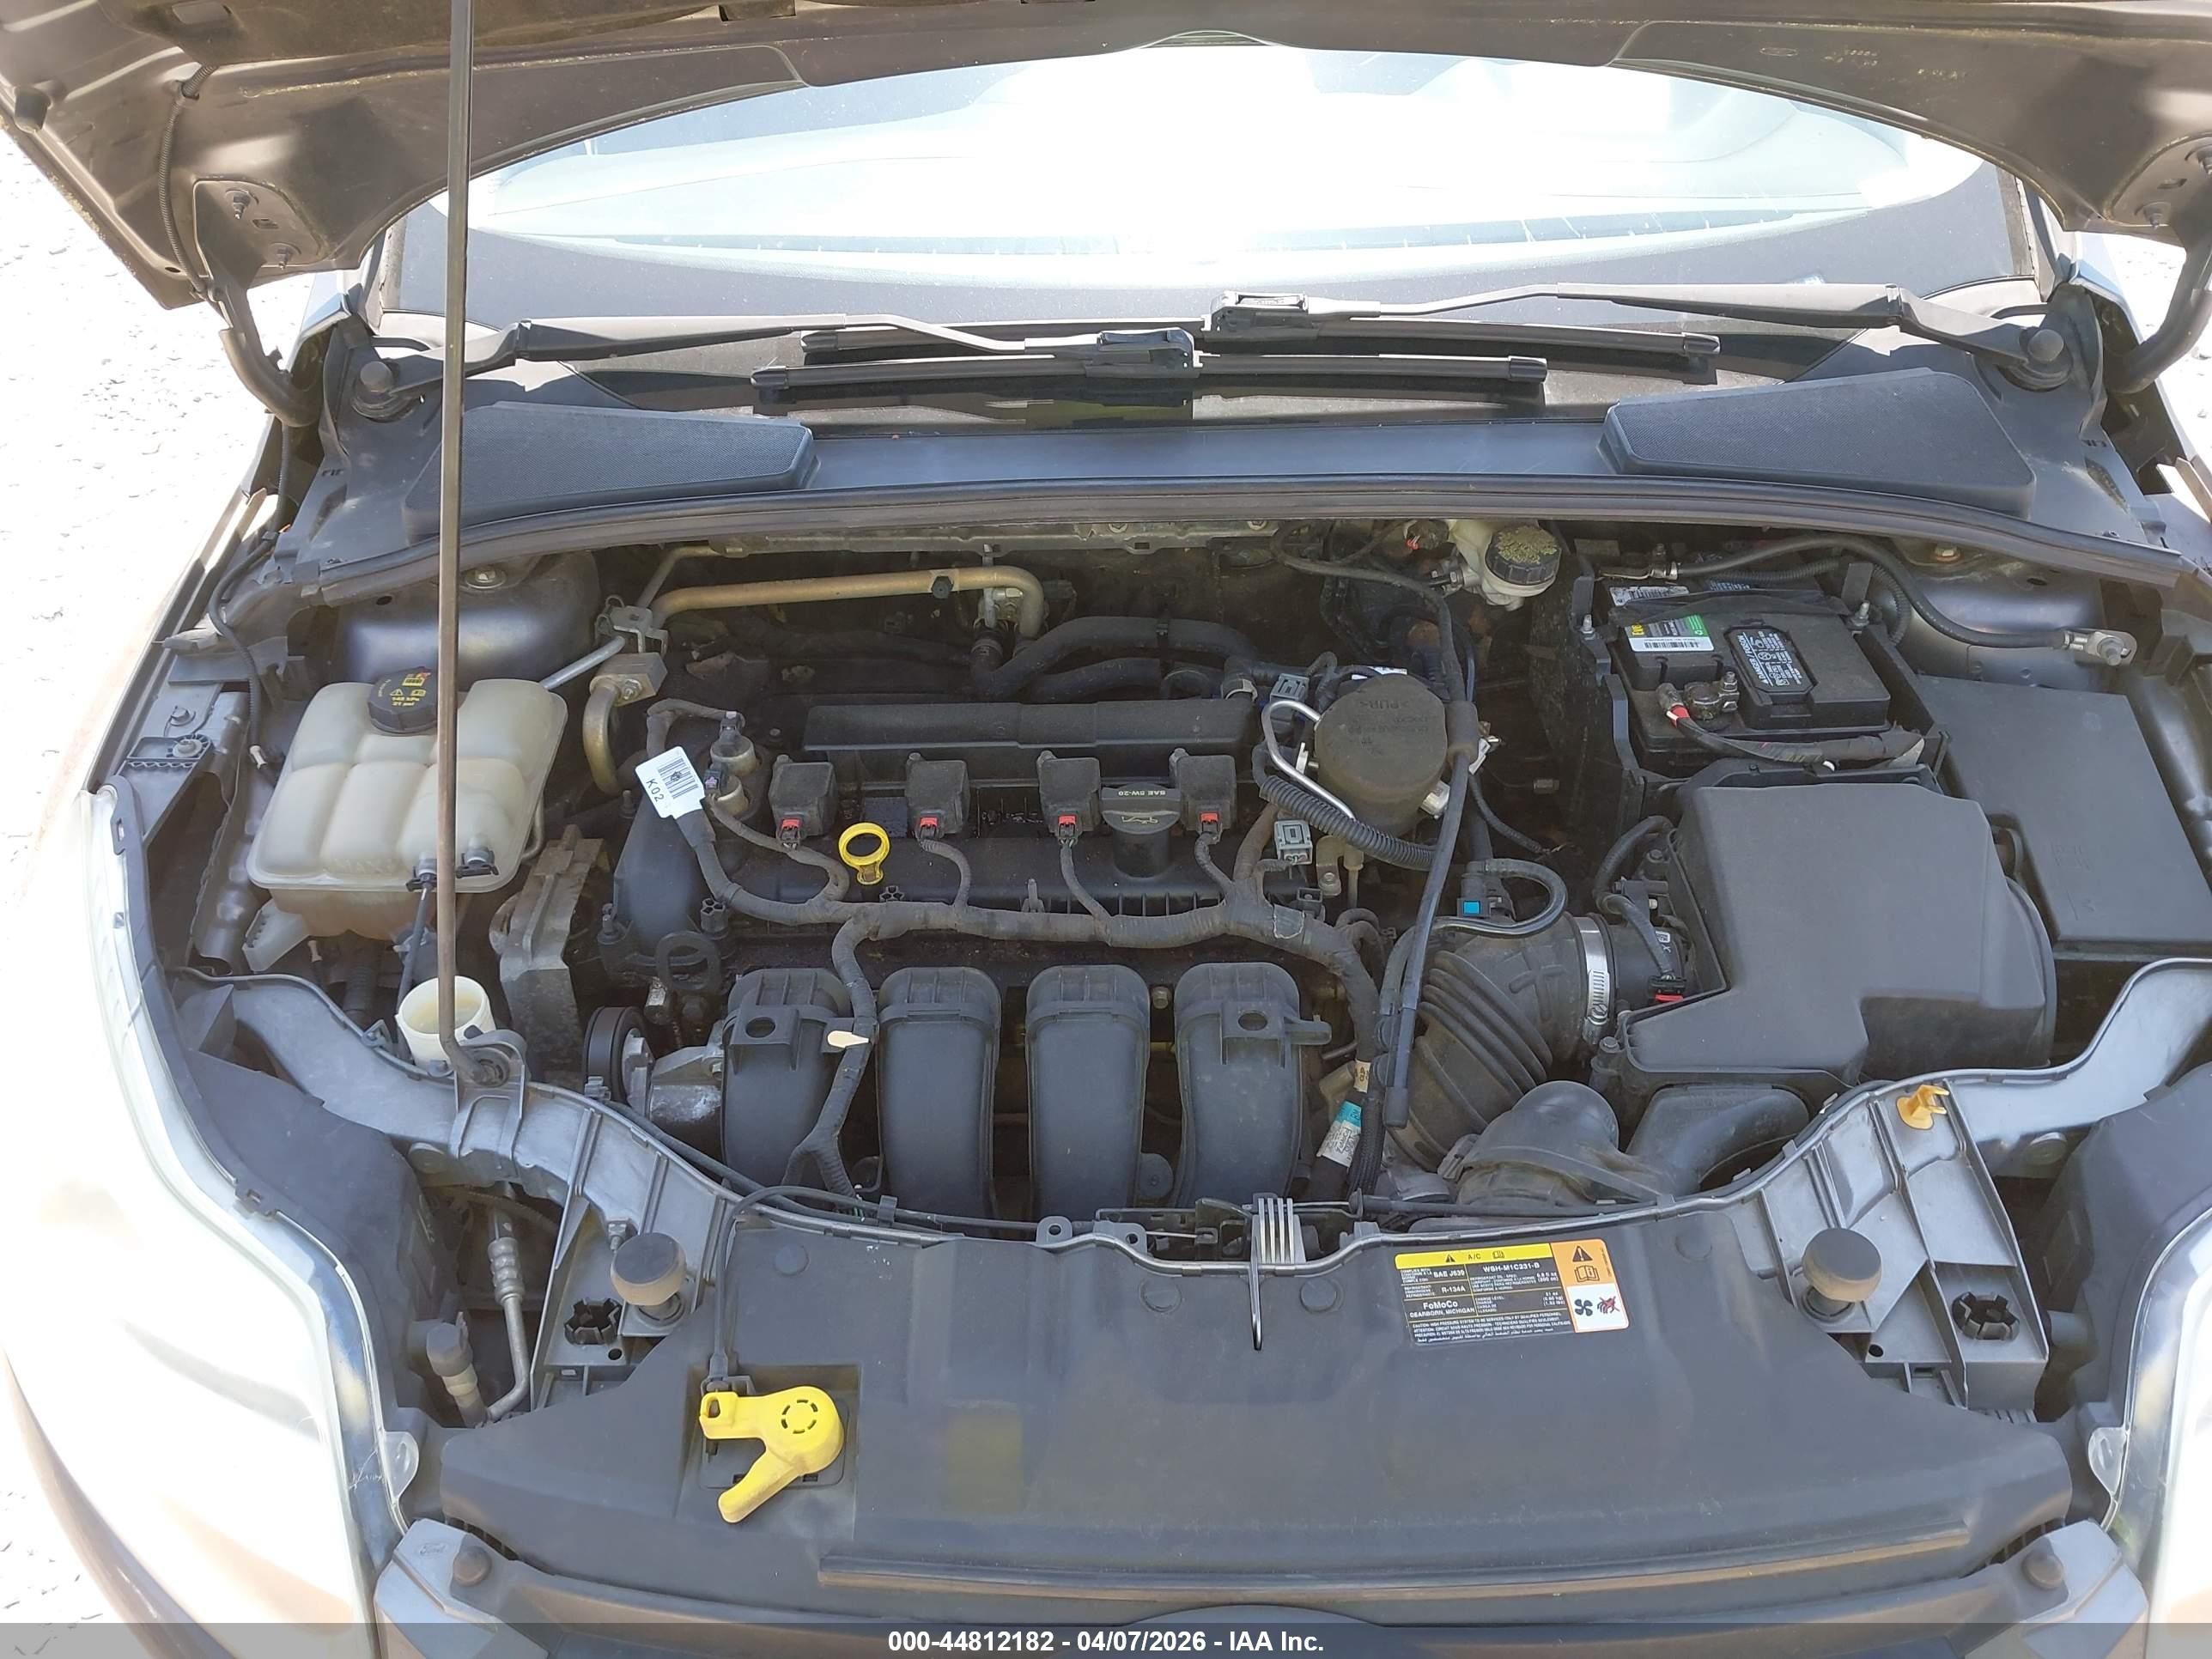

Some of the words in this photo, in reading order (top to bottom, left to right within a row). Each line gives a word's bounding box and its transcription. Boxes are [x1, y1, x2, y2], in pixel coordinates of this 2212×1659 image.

[1749, 658, 1766, 678] DANGER
[646, 778, 665, 802] K02
[1441, 1285, 1466, 1294] R-134A
[1423, 1300, 1458, 1310] FoMoCo
[1409, 1310, 1444, 1318] DEARBORN,
[1446, 1307, 1475, 1316] MICHIGAN
